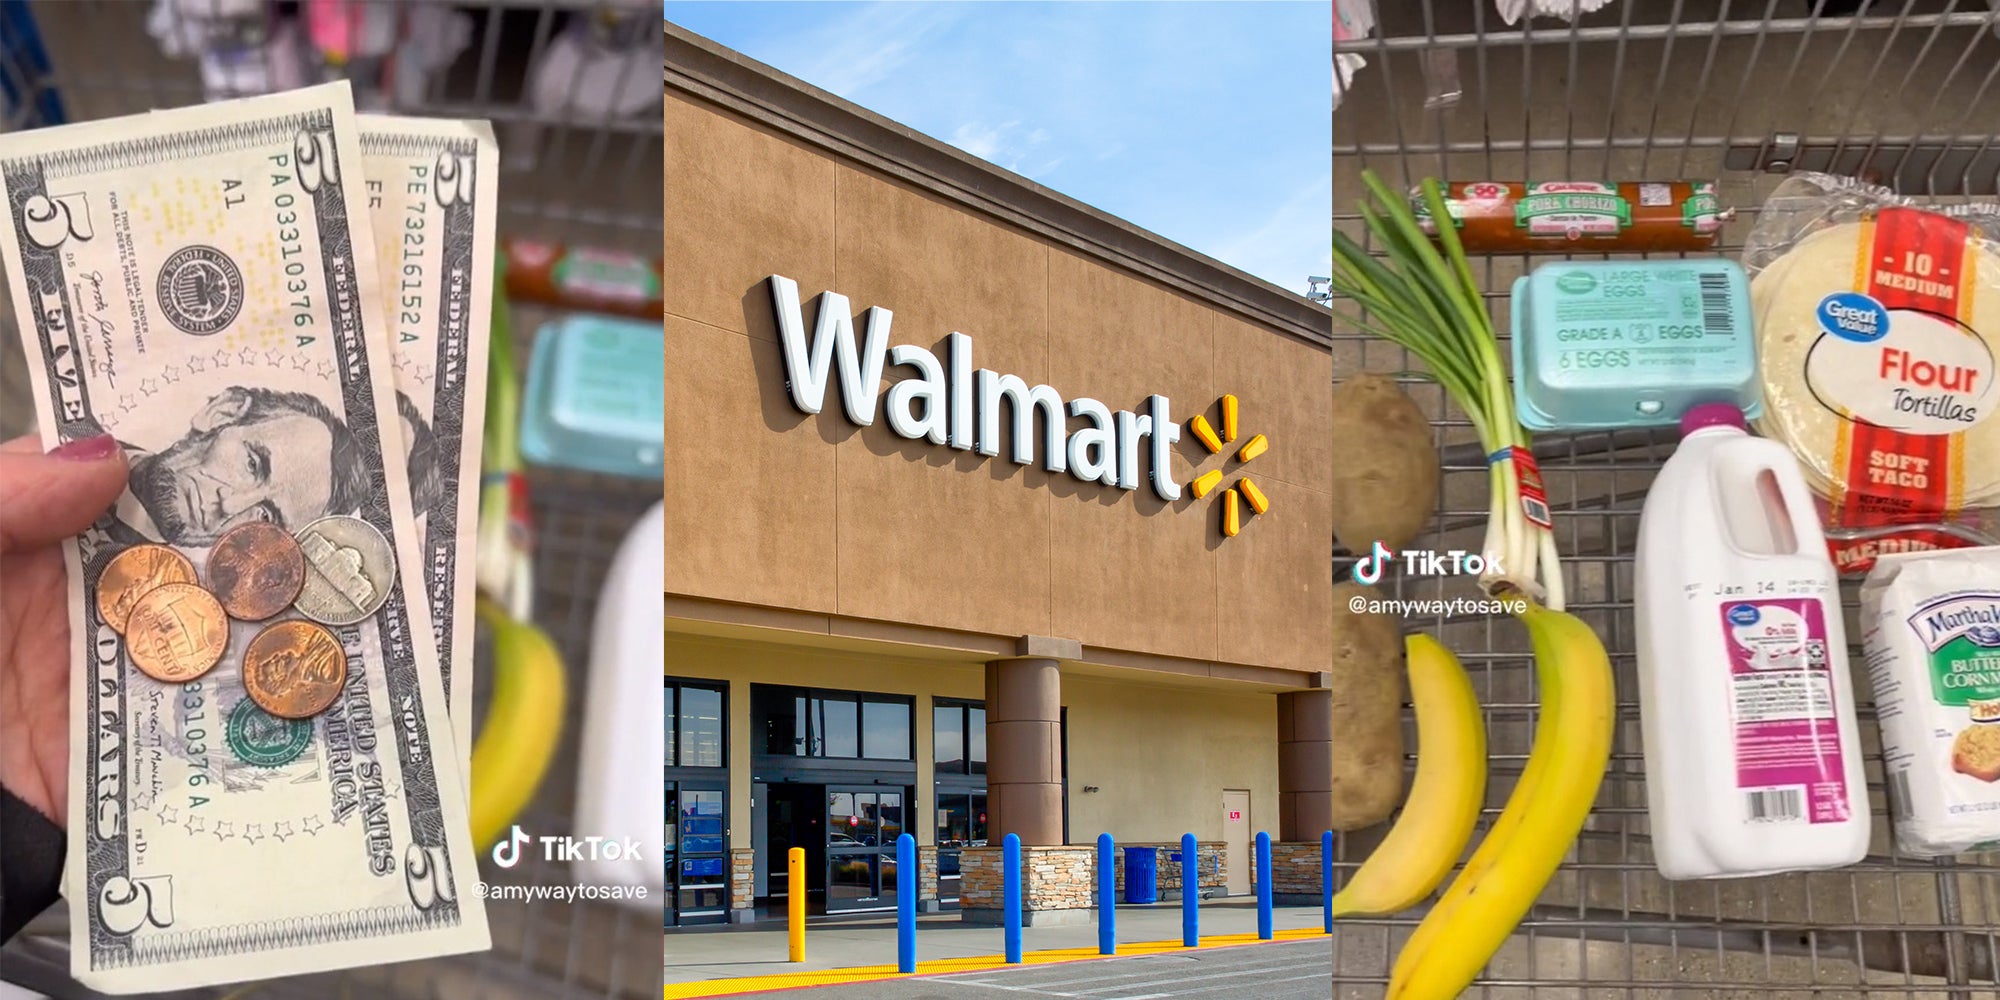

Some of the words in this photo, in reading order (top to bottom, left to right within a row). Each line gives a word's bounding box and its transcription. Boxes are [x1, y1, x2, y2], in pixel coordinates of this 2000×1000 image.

[294, 130, 340, 194] 5
[434, 151, 475, 209] 5
[109, 191, 119, 210] FOR
[22, 190, 94, 250] 5
[112, 212, 122, 229] ALL
[121, 211, 130, 231] THIS
[125, 233, 135, 257] NOTE
[122, 265, 135, 296] PUBLIC
[131, 270, 142, 297] LEGAL
[1602, 271, 1650, 283] LARGE
[1603, 285, 1647, 298] EGGS
[1875, 270, 1955, 299] MEDIUM
[129, 299, 138, 318] AND
[136, 299, 148, 333] TENDER
[332, 257, 361, 382] FEDERAL
[1825, 300, 1878, 325] Great
[133, 320, 145, 354] PRIVATE
[444, 268, 462, 389] FEDERAL
[1556, 327, 1608, 342] GRADE
[1611, 327, 1623, 340] A
[1658, 325, 1703, 340] EGGS
[1838, 316, 1879, 336] Value
[36, 290, 86, 423] FIVE
[1558, 352, 1571, 368] 6
[1576, 350, 1631, 368] EGGS
[1880, 347, 1978, 393] Flour
[769, 274, 1181, 501] Walmart
[1894, 388, 1977, 422] Tortillas
[1869, 450, 1929, 473] SOFT
[1868, 468, 1929, 490] TACO
[1714, 583, 1745, 596] Jan
[1757, 581, 1775, 594] 14
[1926, 606, 1989, 643] Martha
[344, 650, 377, 754] UNITED
[95, 600, 121, 841] OLLARS
[184, 681, 210, 787] 3310376
[399, 695, 422, 764] NOTE
[325, 703, 358, 825] MERICA
[357, 762, 398, 877] STATES
[405, 843, 454, 911] 5
[96, 874, 174, 937] 5
